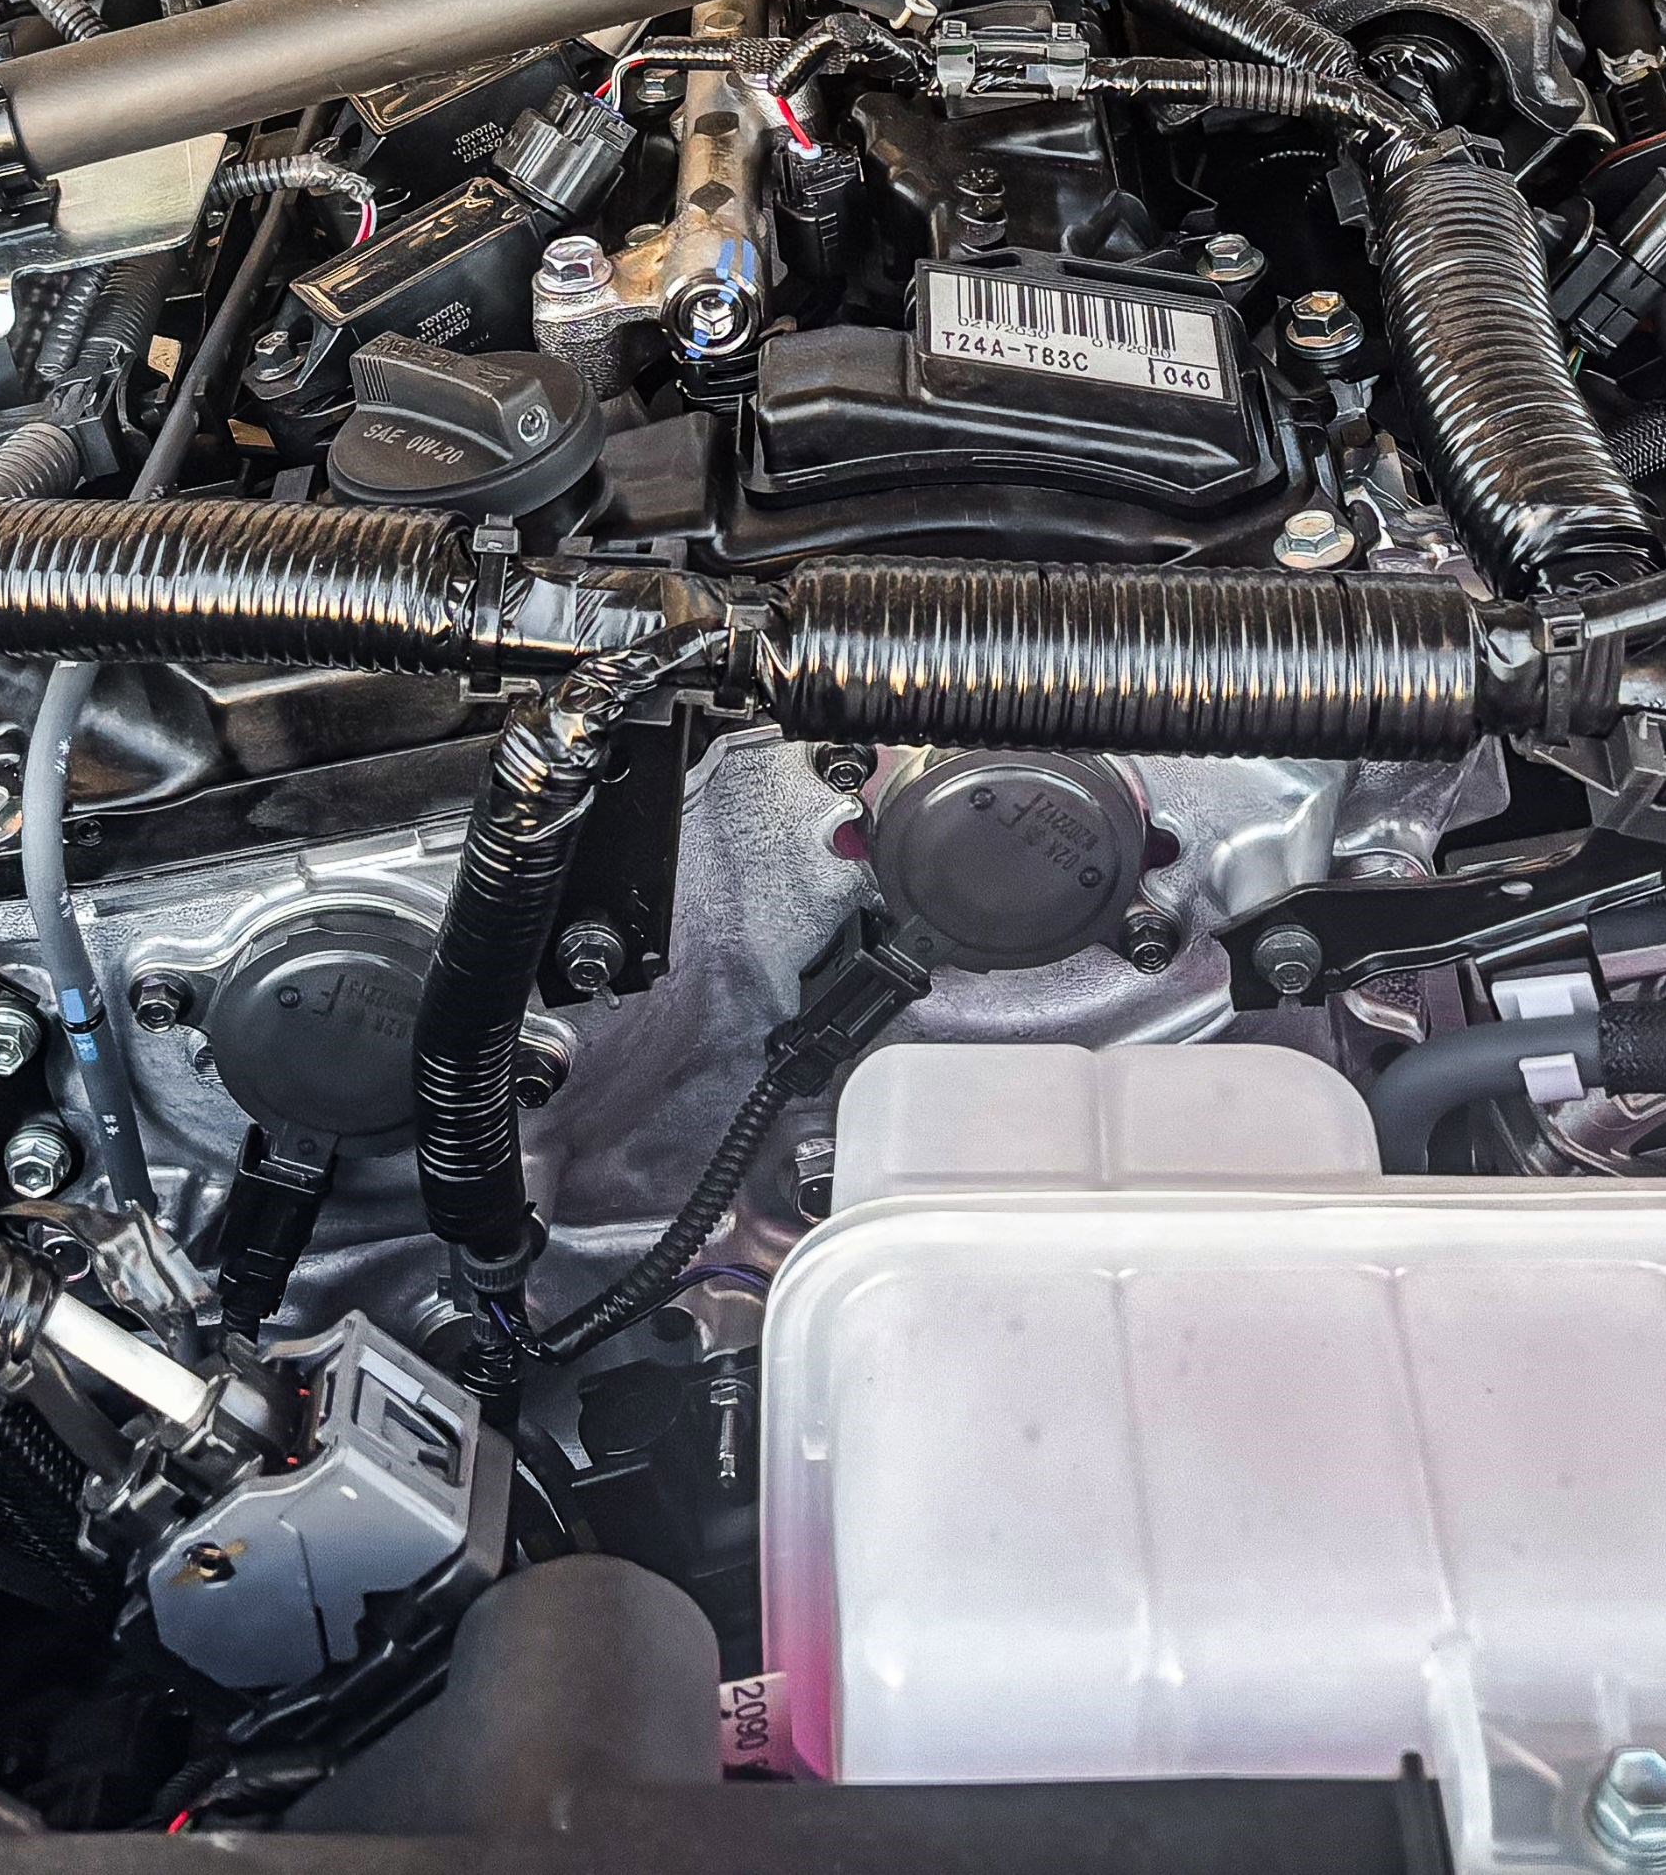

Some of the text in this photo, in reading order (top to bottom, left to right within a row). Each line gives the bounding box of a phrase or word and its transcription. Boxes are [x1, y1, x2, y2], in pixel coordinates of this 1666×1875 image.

[455, 121, 497, 146] TOYOTA
[463, 137, 503, 163] DENSO
[416, 301, 464, 331] TOYOTA
[428, 318, 470, 346] DENSO
[363, 423, 465, 465] SAE 0W-20
